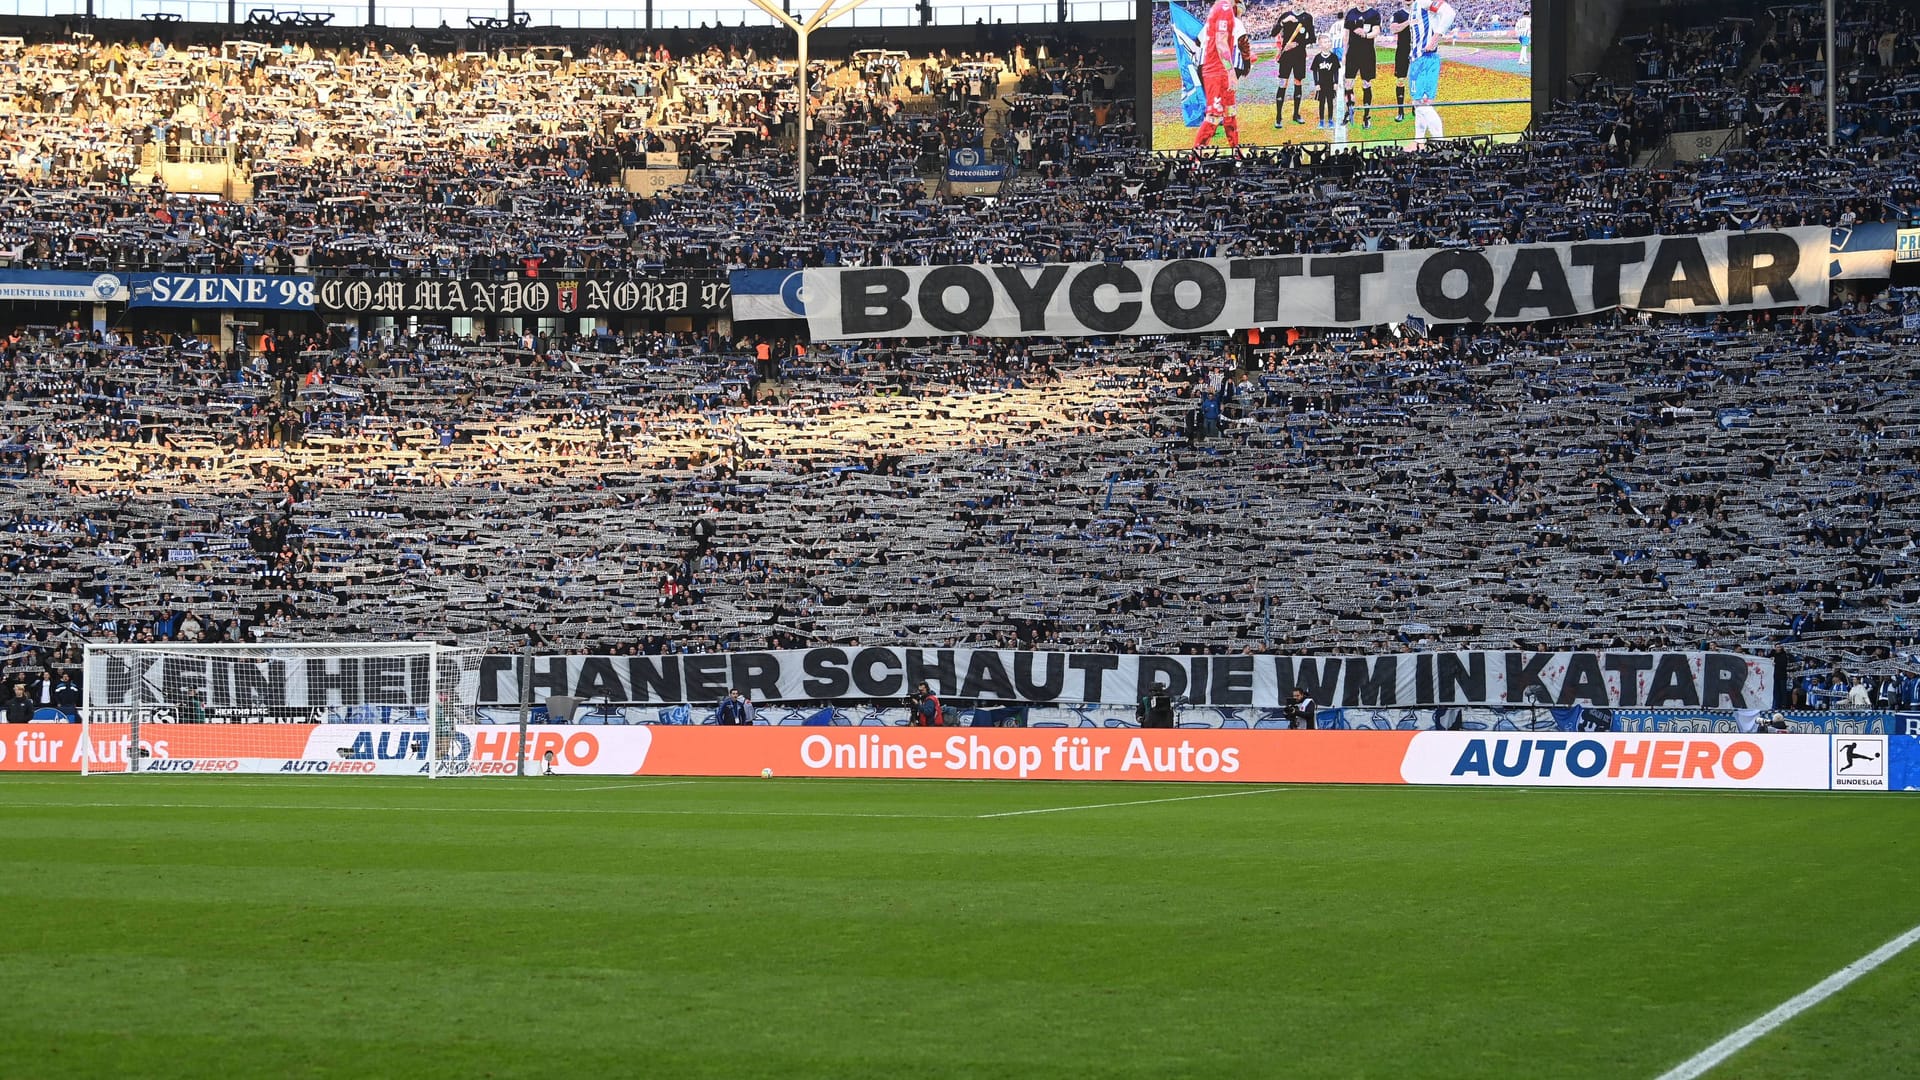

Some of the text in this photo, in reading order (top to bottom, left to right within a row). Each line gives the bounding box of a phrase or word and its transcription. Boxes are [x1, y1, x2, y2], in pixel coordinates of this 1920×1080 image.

[1319, 62, 1333, 71] sky
[1695, 136, 1713, 148] 38
[650, 175, 665, 186] 36
[840, 231, 1800, 336] BOYCOTT QATAR
[53, 289, 86, 298] ERBEN
[586, 279, 689, 312] NORD
[107, 656, 286, 707] KEIN
[803, 647, 1118, 703] SCHAUT
[1137, 654, 1254, 705] DIE
[1276, 655, 1397, 707] WM
[1415, 651, 1487, 705] IN
[1506, 651, 1748, 709] KATAR
[15, 731, 63, 763] für
[800, 733, 1240, 778] Online-Shop für Autos
[1451, 739, 1764, 780] AUTOHERO
[146, 759, 240, 772] AUTOHERO
[280, 760, 376, 773] AUTOHERO
[1836, 778, 1883, 786] BUNDESLIGA
